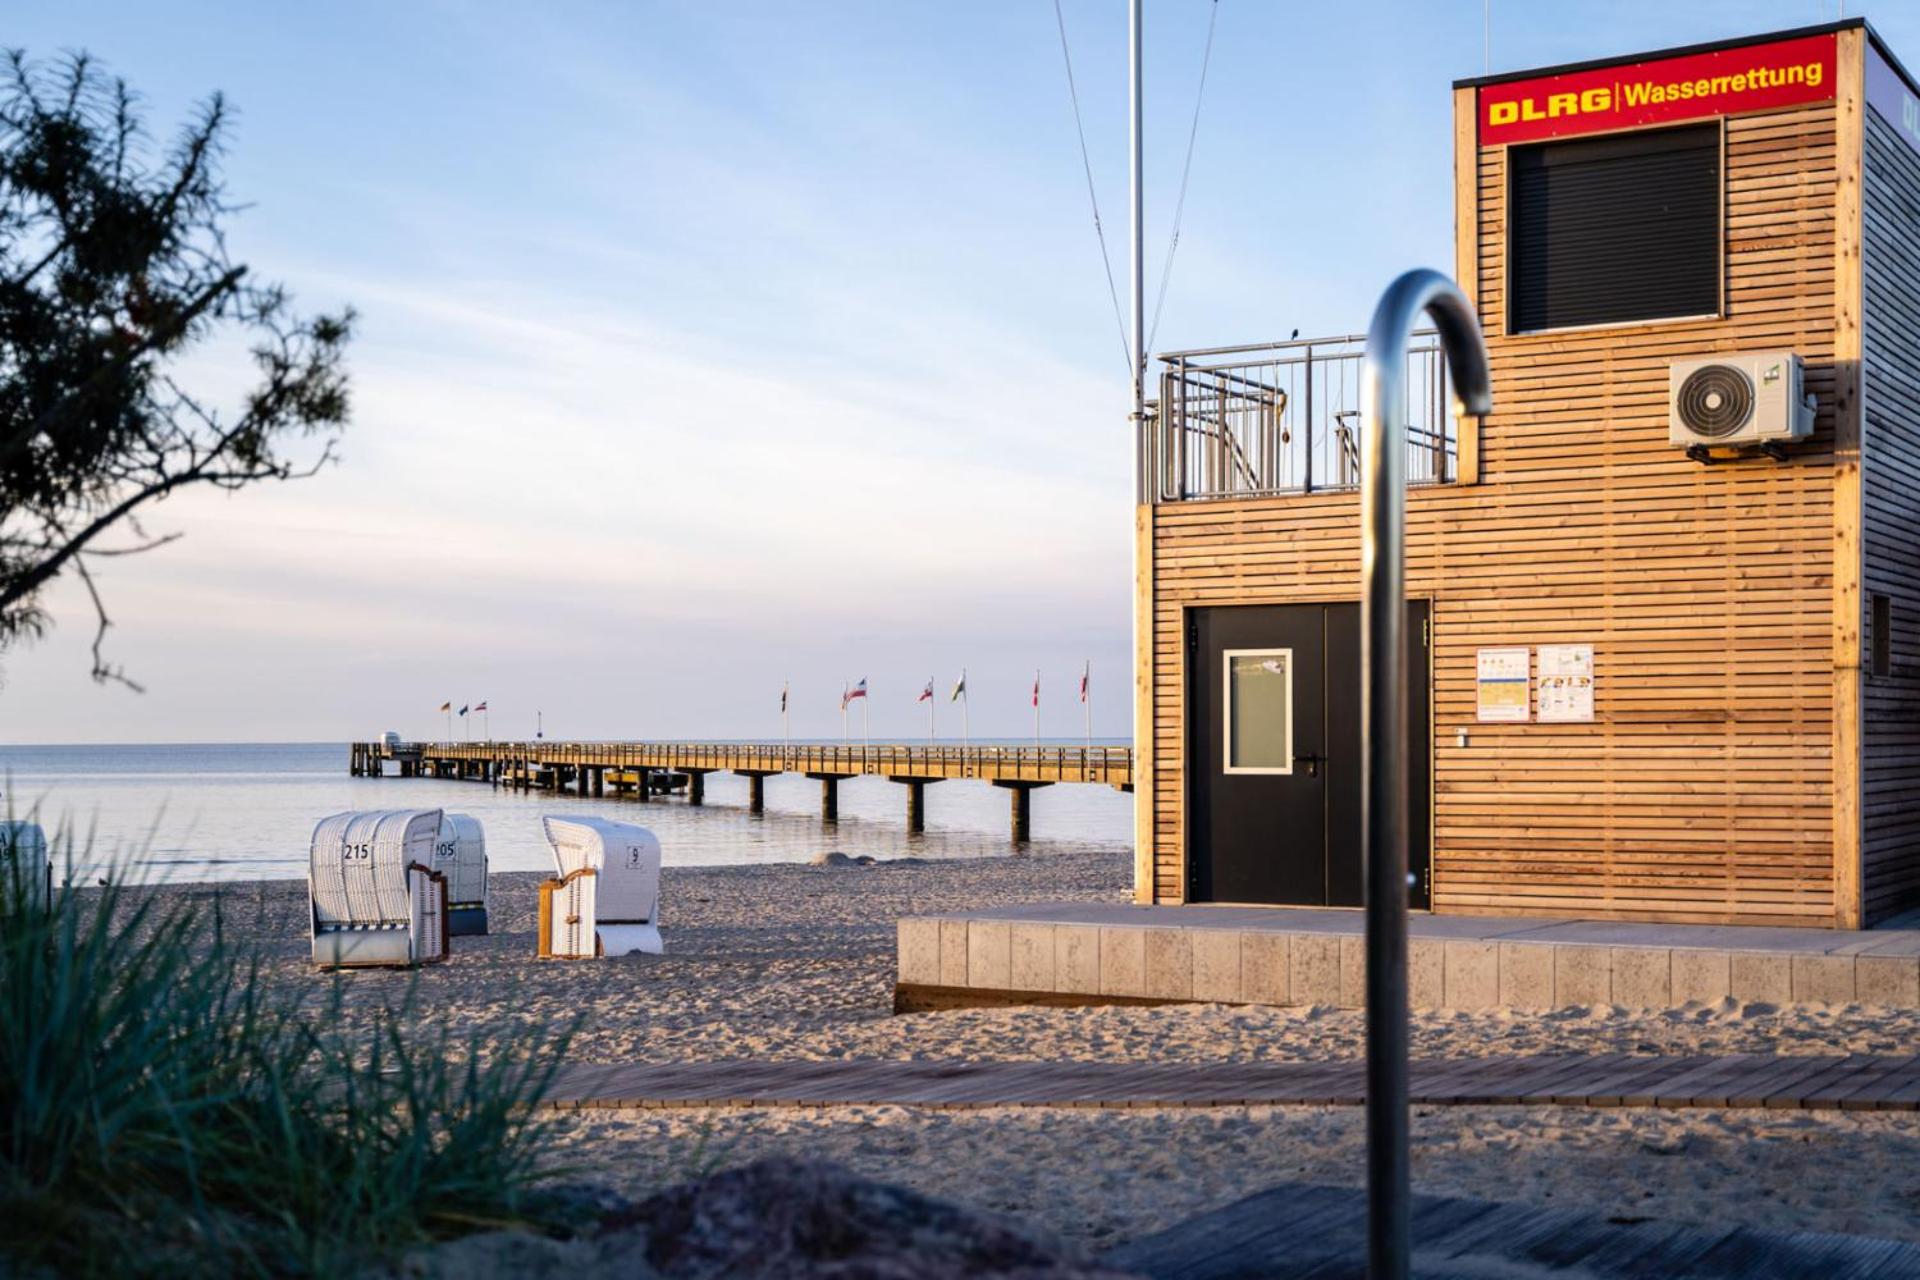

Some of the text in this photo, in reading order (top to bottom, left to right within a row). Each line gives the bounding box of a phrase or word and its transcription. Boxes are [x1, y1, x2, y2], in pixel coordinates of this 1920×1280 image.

[1489, 61, 1823, 126] DLRG Wasserrettung
[345, 844, 368, 859] 215
